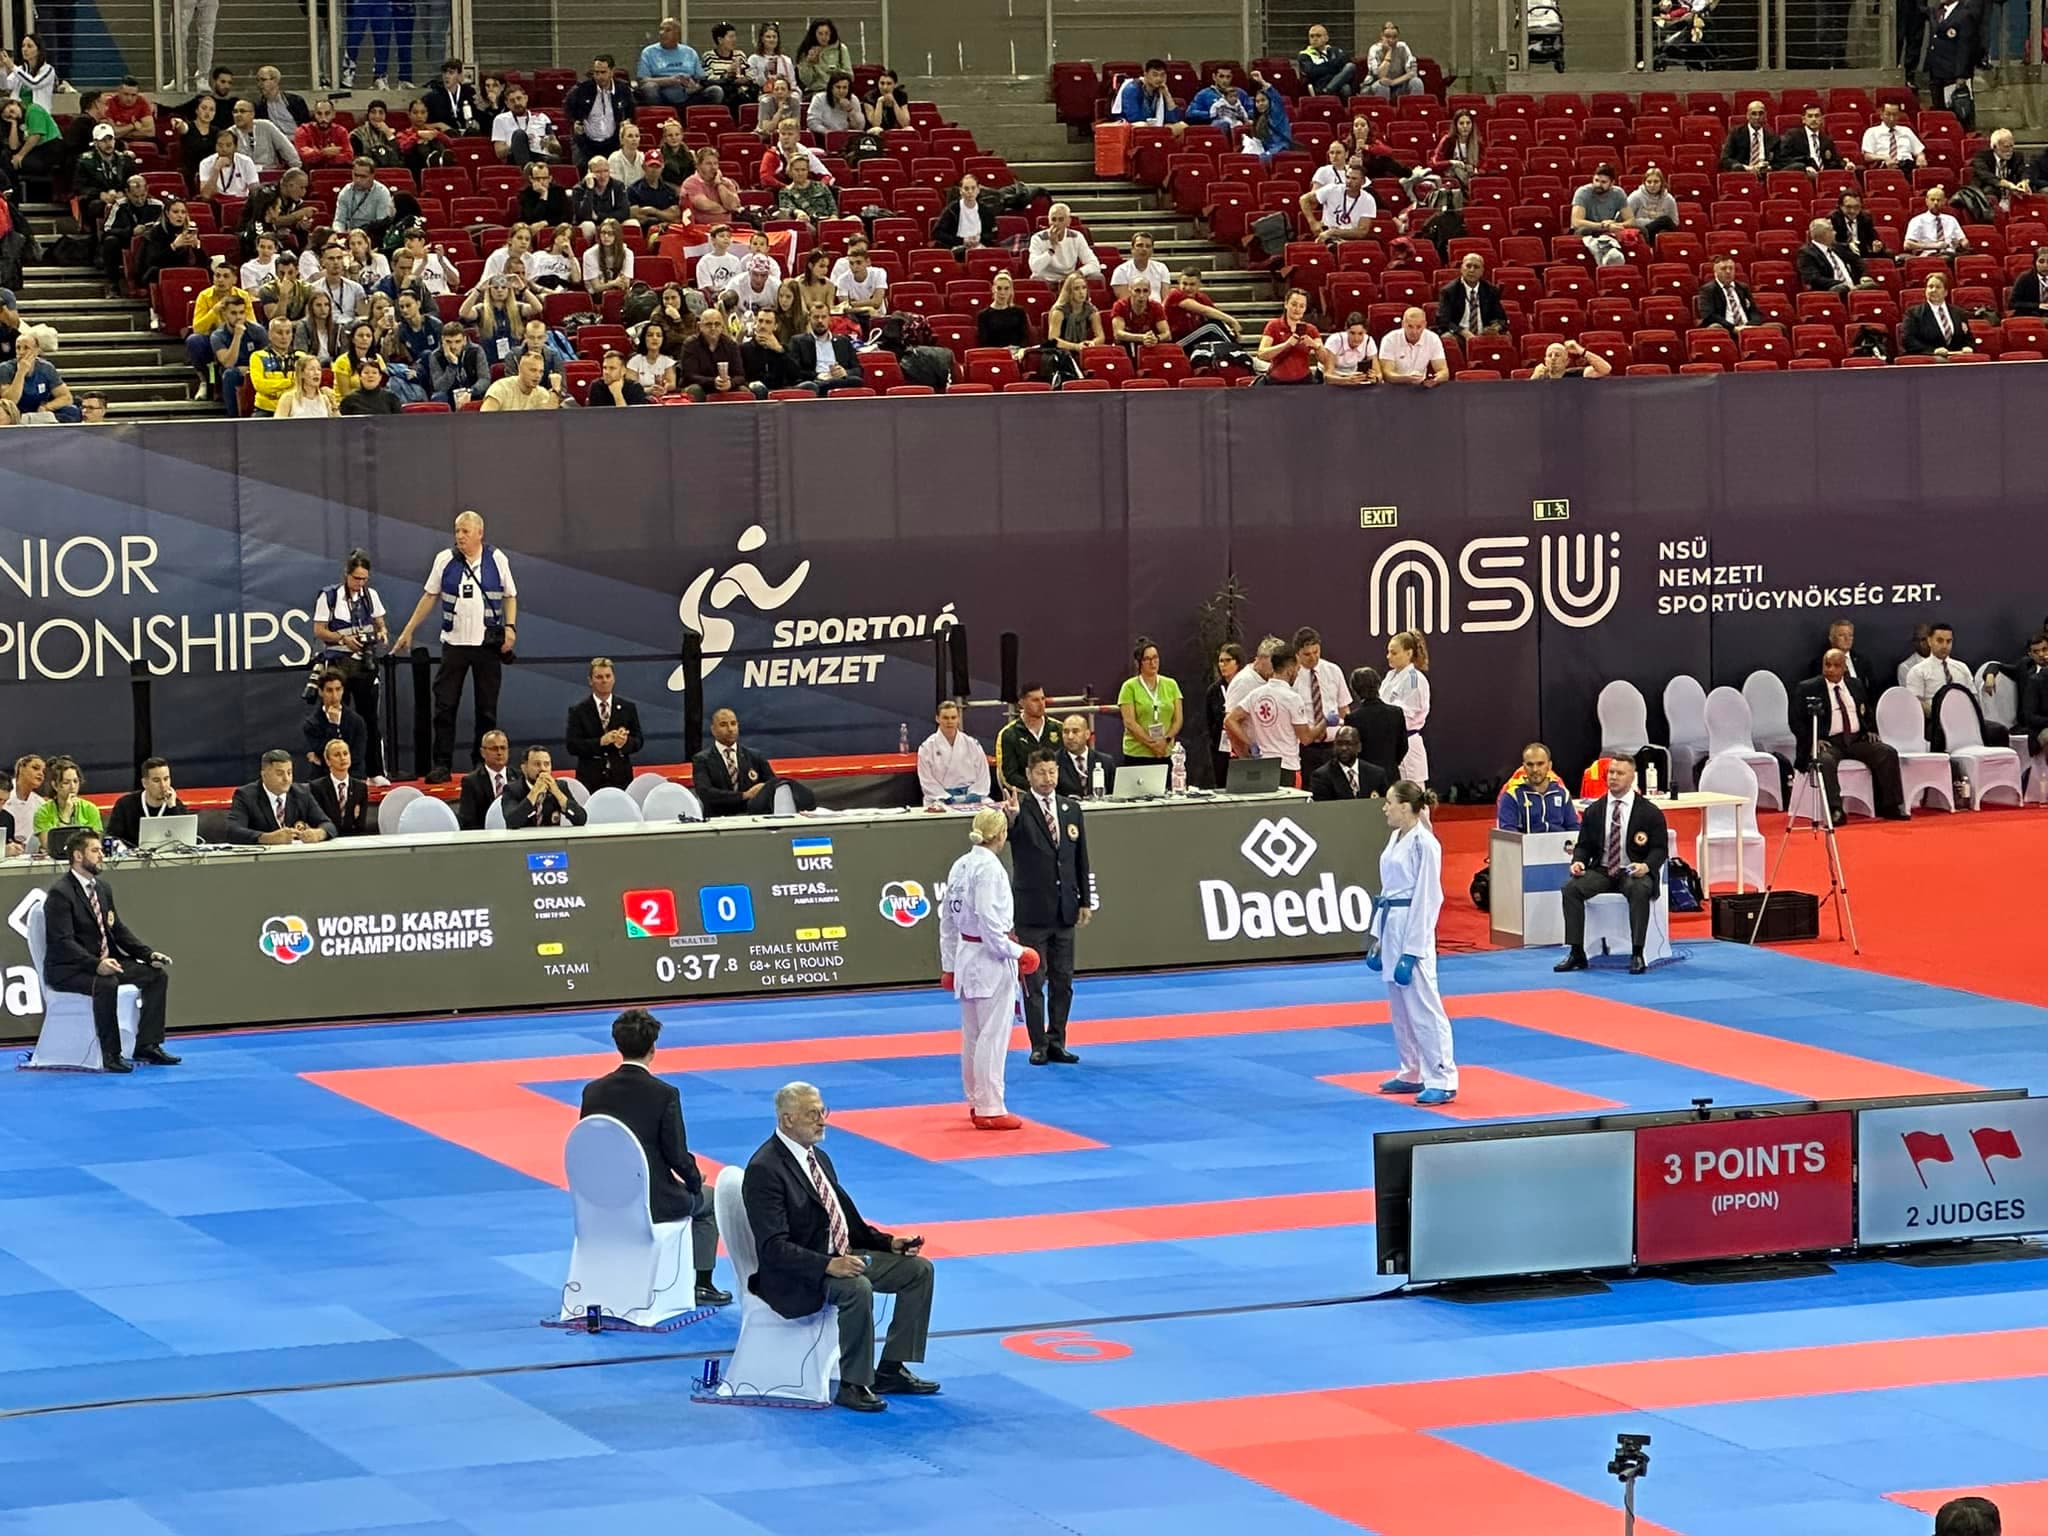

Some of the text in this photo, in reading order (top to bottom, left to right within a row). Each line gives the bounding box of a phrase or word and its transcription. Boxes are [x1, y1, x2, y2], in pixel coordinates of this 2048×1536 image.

[1364, 511, 1394, 525] EXIT
[1658, 536, 1708, 560] NSÜ
[1658, 565, 1763, 587] NEMZETI
[1658, 582, 1942, 615] SPORTÜGYNÖKSÉG ZRT.
[743, 654, 886, 688] NEMZET
[796, 857, 833, 871] UKR
[531, 871, 569, 886] KOS
[771, 882, 838, 897] STEPAS...
[533, 896, 586, 910] ORANA
[717, 895, 737, 921] 0
[889, 895, 919, 910] WKF
[1199, 872, 1373, 941] Daedo
[640, 899, 661, 926] 2
[317, 908, 490, 937] WORLD KARATE
[270, 930, 302, 946] WKF
[321, 929, 493, 957] CHAMPIONSHIPS
[749, 940, 840, 956] FEMALE KUMITE
[543, 963, 590, 976] TATAMI
[749, 960, 771, 971] 68+
[774, 959, 791, 970] KG
[799, 955, 844, 968] ROUND
[567, 979, 576, 990] 5
[796, 972, 830, 983] POOL
[831, 971, 839, 981] 1
[1663, 1141, 1826, 1185] 3 POINTS
[1711, 1191, 1779, 1216] (IPPON)
[1906, 1198, 2025, 1227] 2 JUDGES
